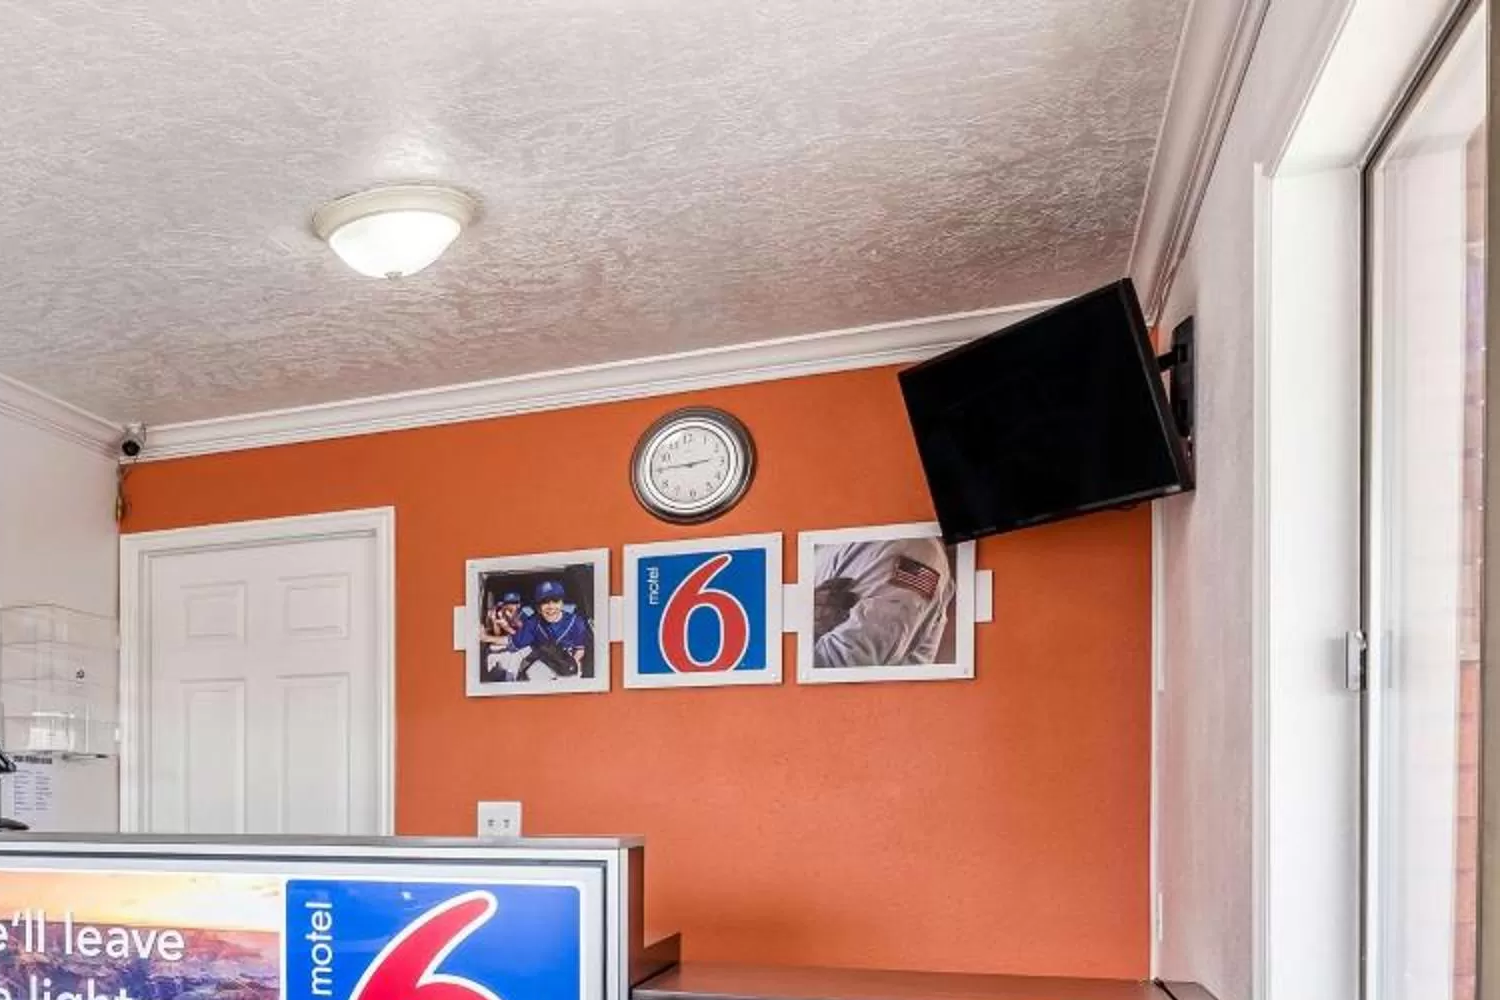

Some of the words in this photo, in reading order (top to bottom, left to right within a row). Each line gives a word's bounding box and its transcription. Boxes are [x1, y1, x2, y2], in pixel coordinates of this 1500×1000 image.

[646, 567, 660, 605] motel
[658, 553, 750, 673] 6
[63, 920, 186, 963] leave
[310, 901, 333, 996] motel
